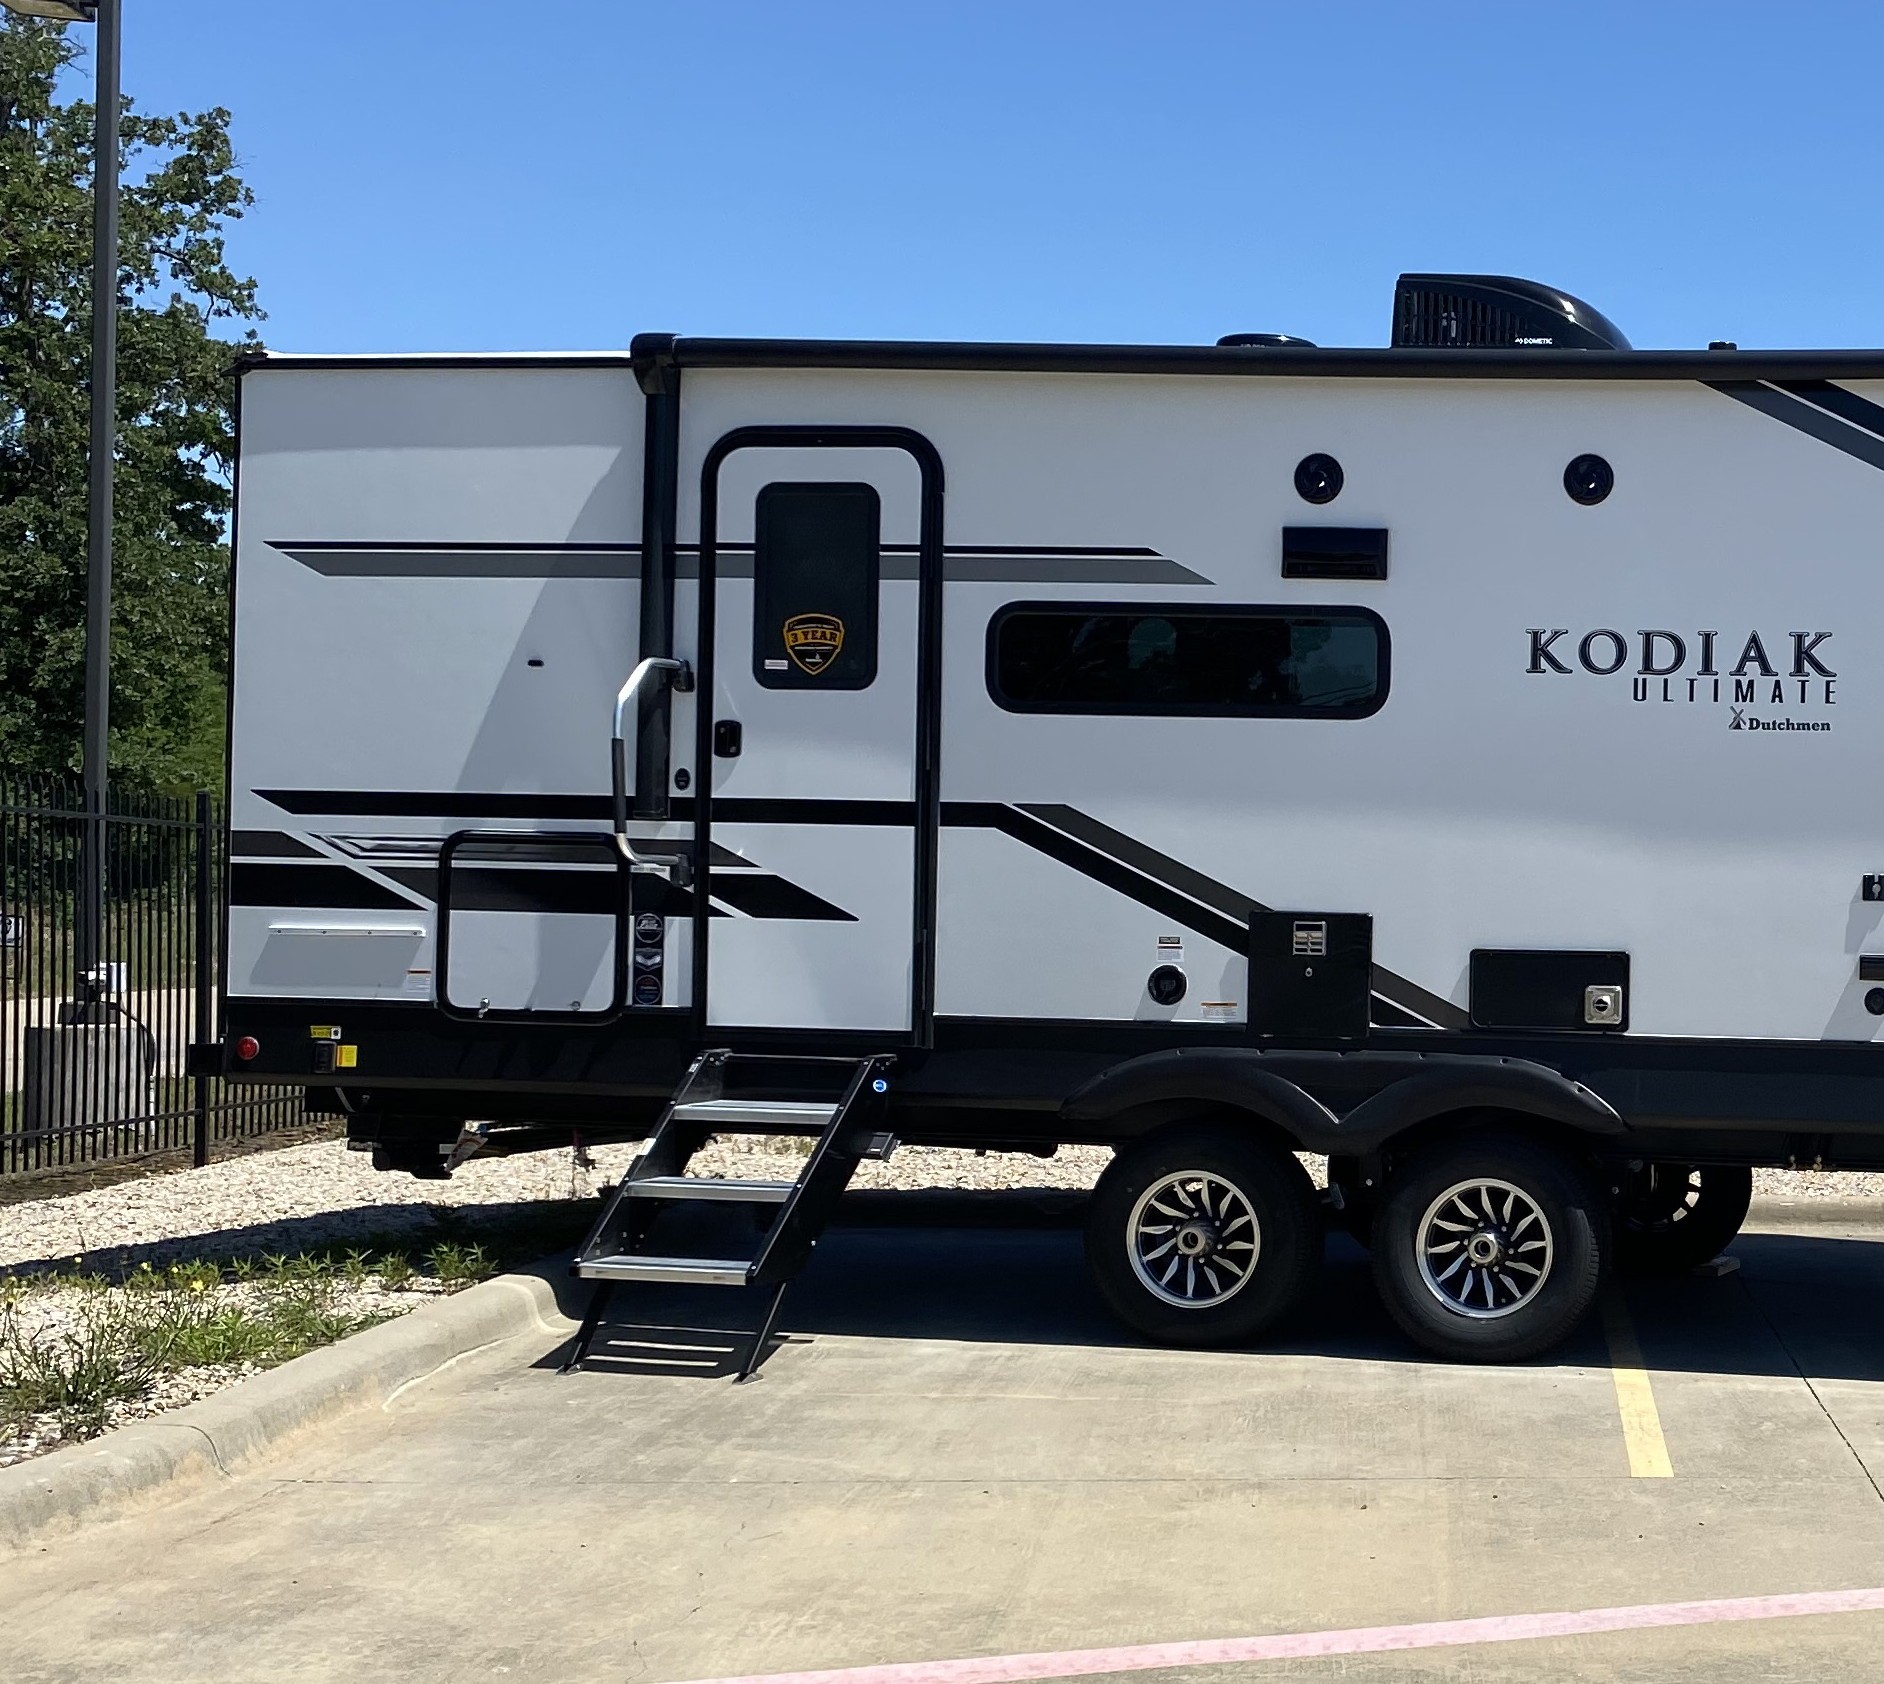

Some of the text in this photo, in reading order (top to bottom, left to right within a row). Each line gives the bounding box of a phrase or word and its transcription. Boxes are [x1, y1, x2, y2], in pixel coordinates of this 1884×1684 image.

[790, 629, 838, 643] 3 YEAR
[1525, 628, 1837, 677] KODIAK
[1633, 677, 1836, 704] ULTIMATE
[1748, 717, 1831, 732] Dutchmen
